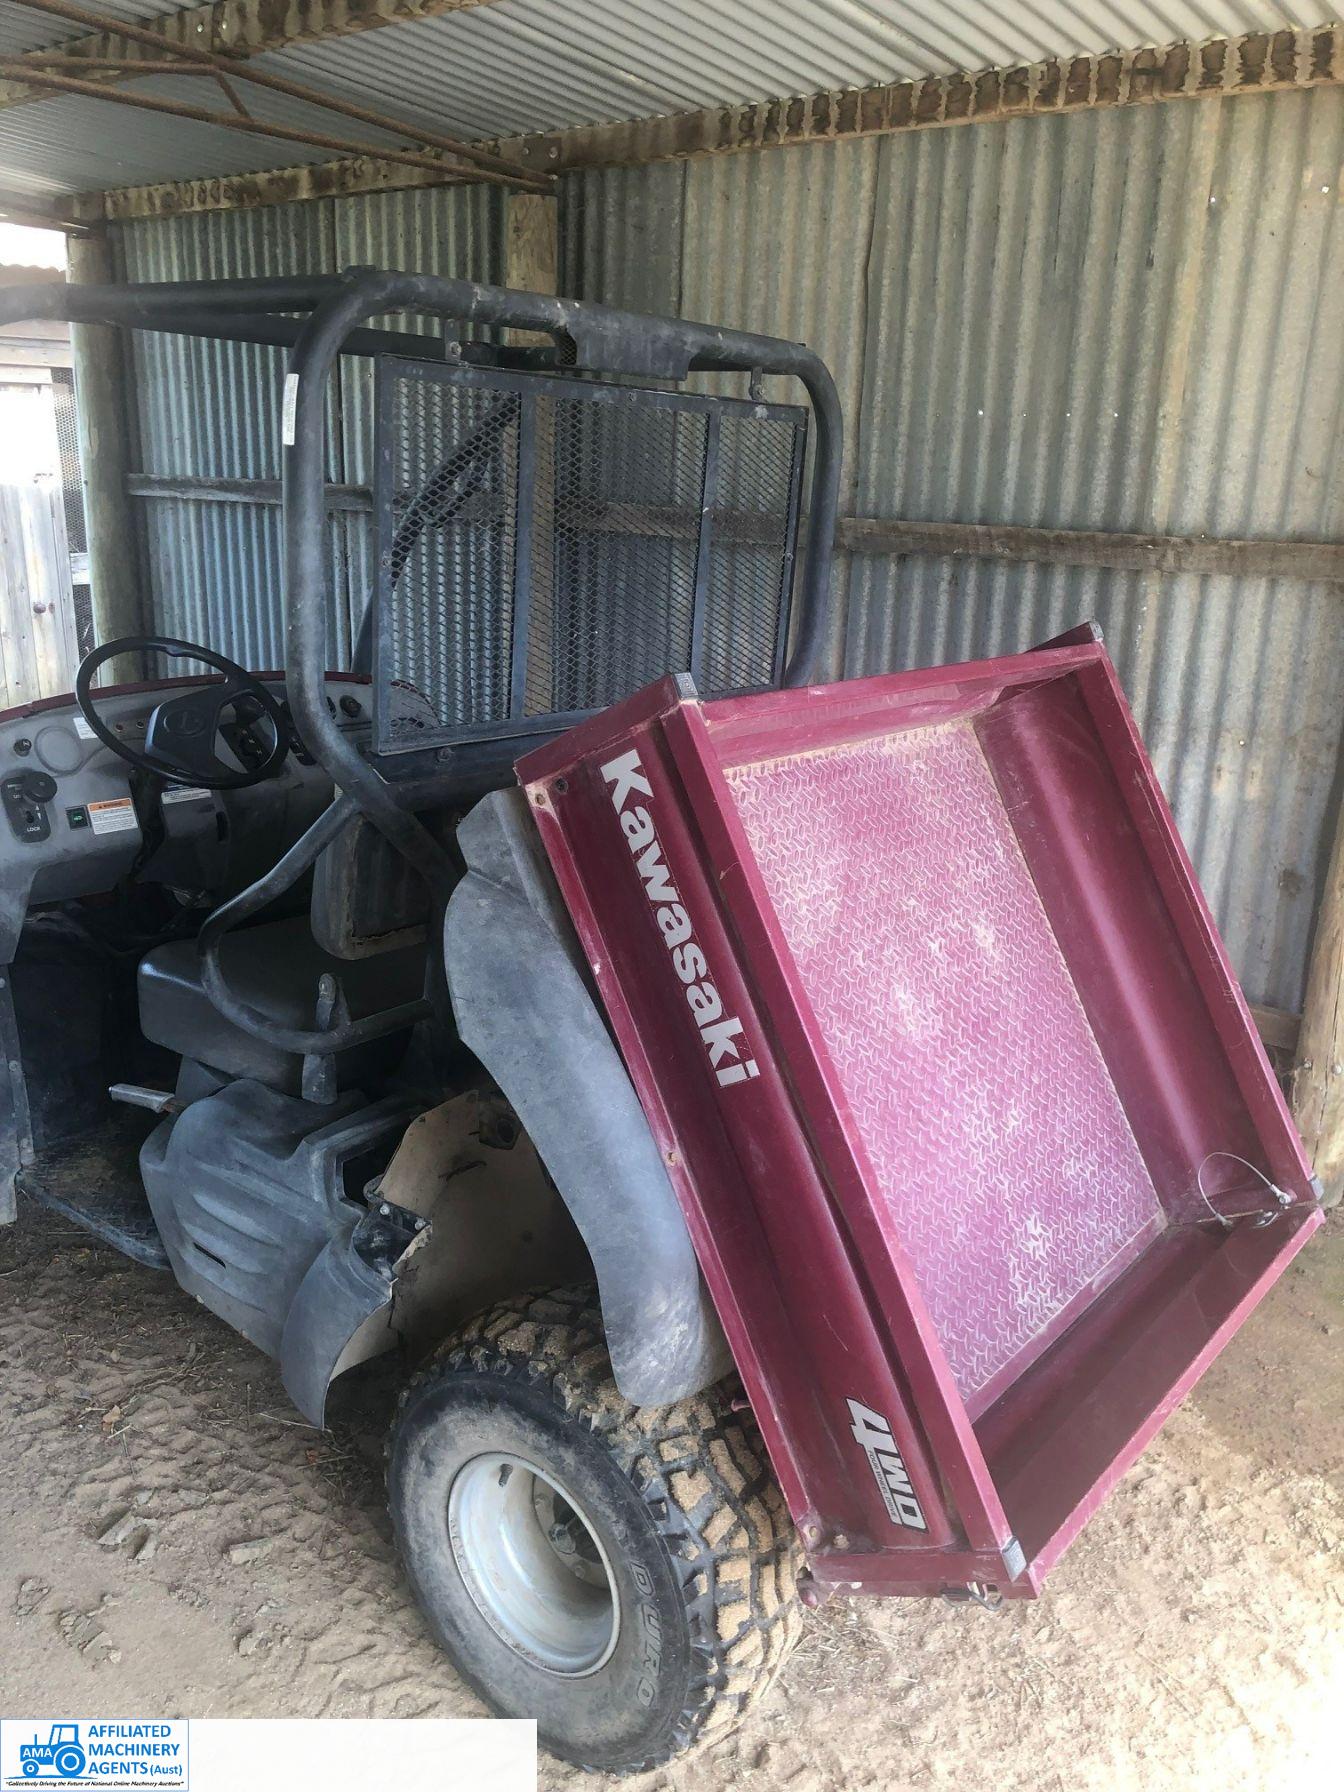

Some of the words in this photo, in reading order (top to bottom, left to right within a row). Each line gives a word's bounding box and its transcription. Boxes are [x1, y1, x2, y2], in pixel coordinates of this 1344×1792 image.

[600, 749, 760, 1088] Kawasaki
[846, 1397, 927, 1530] 4WD
[629, 1560, 662, 1707] DURO
